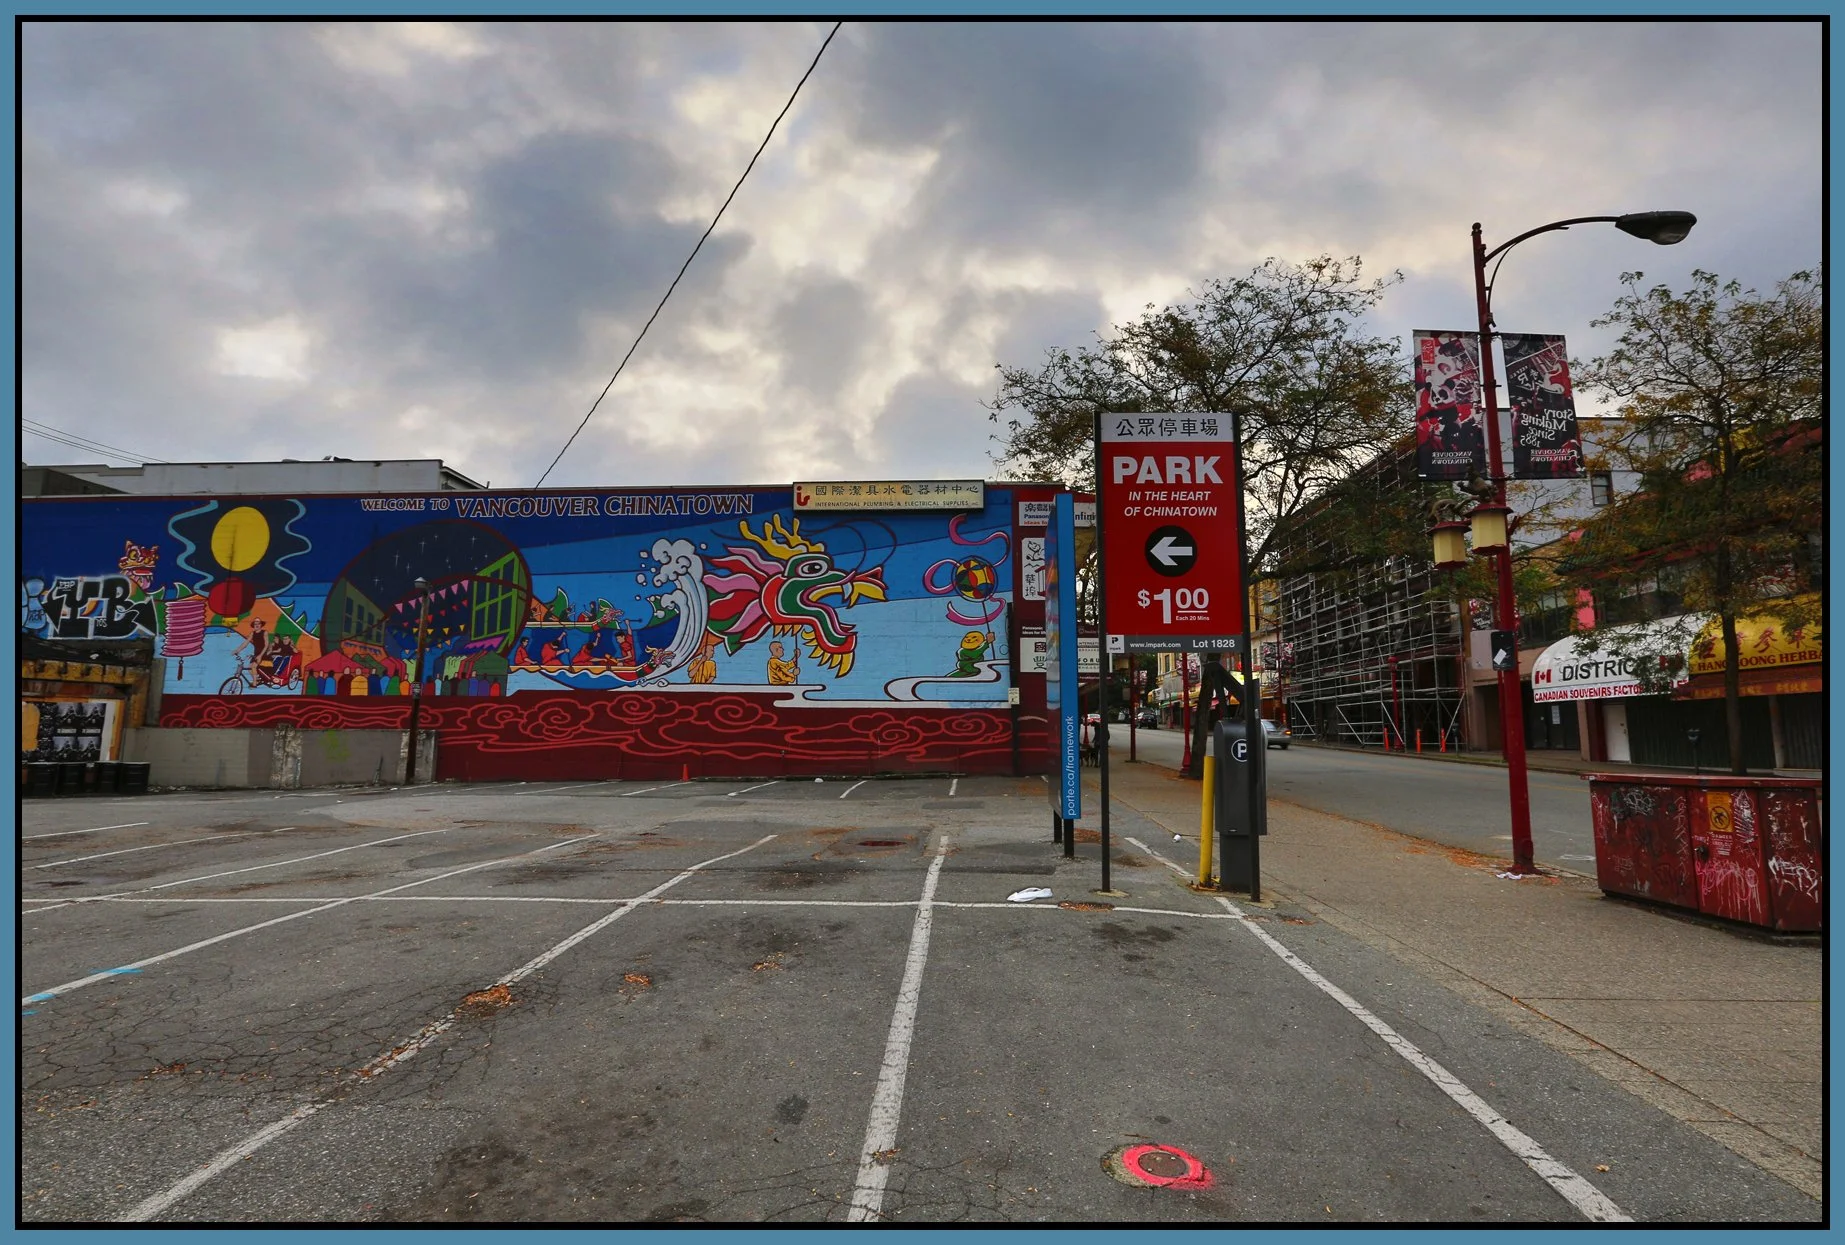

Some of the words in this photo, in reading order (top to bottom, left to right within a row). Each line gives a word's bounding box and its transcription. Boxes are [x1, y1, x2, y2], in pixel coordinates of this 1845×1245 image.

[1116, 418, 1218, 436] 公眾停車場
[1112, 455, 1224, 484] PARK
[1128, 491, 1141, 501] IN
[1144, 491, 1168, 501] THE
[1171, 491, 1211, 501] HEART
[360, 498, 425, 511] WELCOME
[430, 498, 450, 511] TO
[454, 496, 600, 518] VANCOUVER
[604, 494, 754, 516] CHINATOWN
[1124, 506, 1141, 517] OF
[1143, 506, 1218, 517] CHINATOWN
[1192, 639, 1209, 648] Lot
[1211, 639, 1236, 648] 1828
[1534, 690, 1568, 702] CANADIAN
[1569, 686, 1612, 699] SOUVENIRS
[1065, 715, 1076, 816] porte.ca/framework
